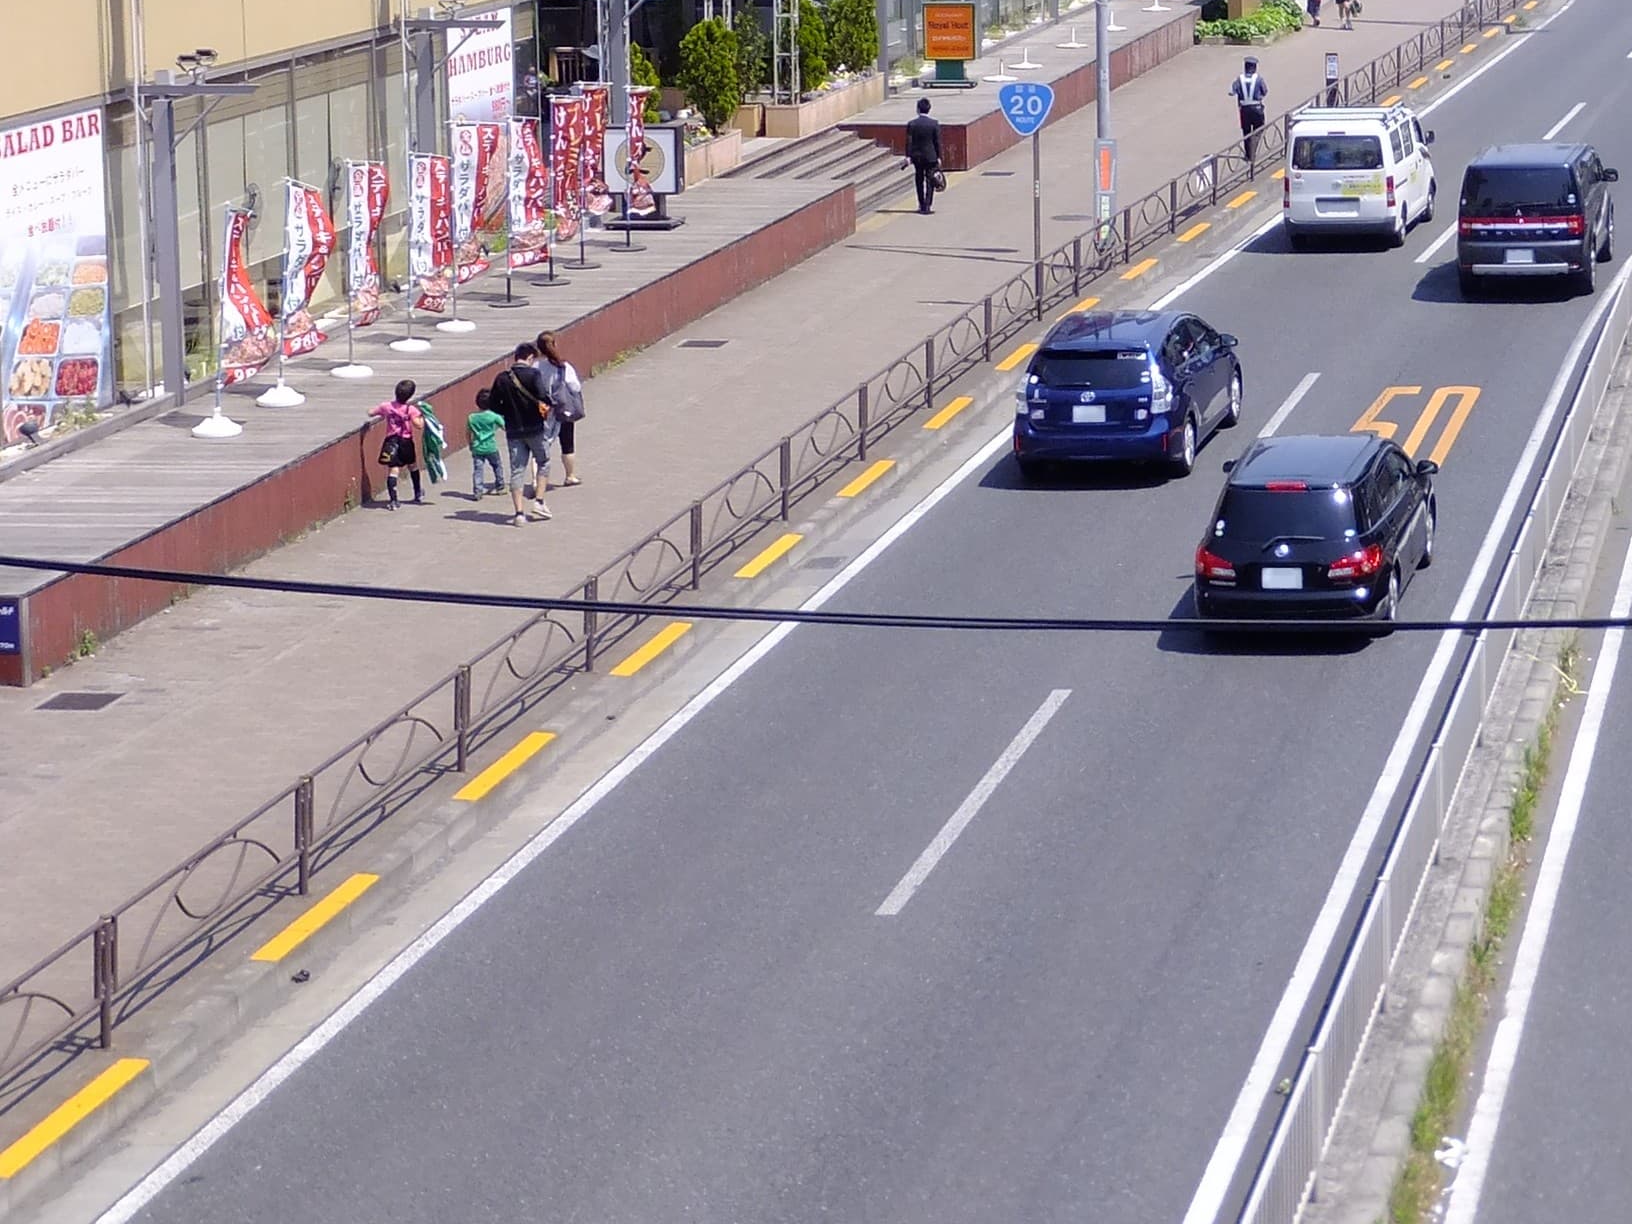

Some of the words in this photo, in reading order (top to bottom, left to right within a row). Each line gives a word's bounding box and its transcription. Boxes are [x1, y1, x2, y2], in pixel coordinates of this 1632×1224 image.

[447, 42, 512, 79] HAMBURG
[1009, 94, 1043, 115] 20
[0, 123, 55, 160] ALAD
[62, 113, 100, 144] BAR
